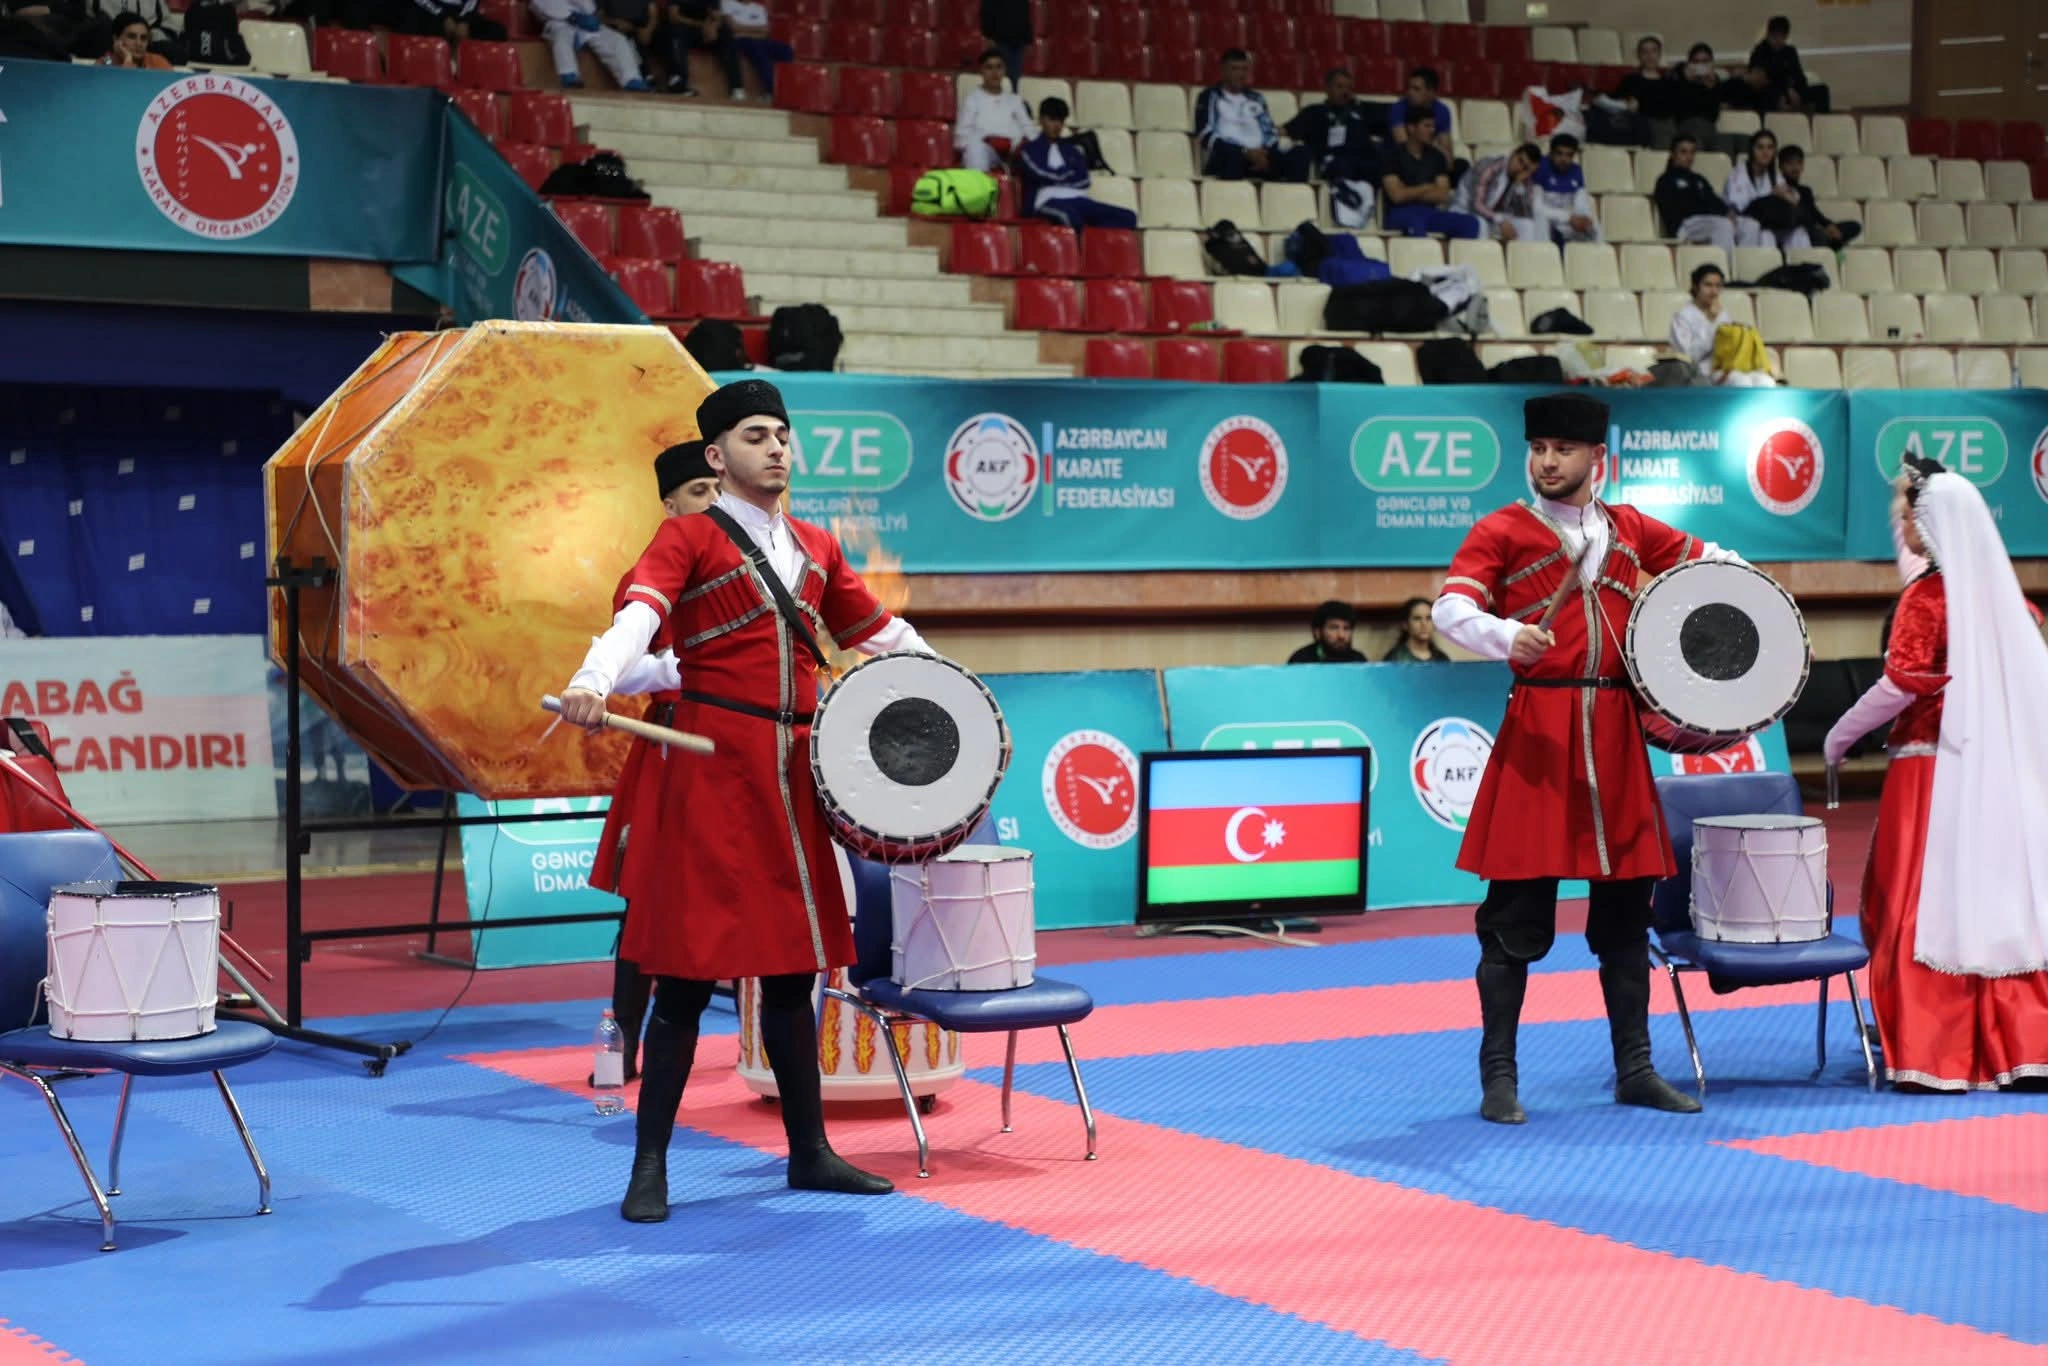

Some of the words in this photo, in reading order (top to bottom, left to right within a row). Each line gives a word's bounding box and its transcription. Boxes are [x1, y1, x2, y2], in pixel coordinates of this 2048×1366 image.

[148, 77, 286, 131] AZERBAIJAN
[143, 166, 188, 223] KARATE
[195, 174, 294, 236] ORGANIZATION
[457, 183, 500, 259] AZE
[1056, 428, 1168, 449] AZƏRBAYCAN
[1622, 430, 1720, 450] AZƏRBAYCAN
[1378, 431, 1473, 477] AZE
[975, 459, 1012, 474] AKF
[1056, 458, 1122, 479] KARATE
[1622, 458, 1680, 478] KARATE
[1056, 483, 1174, 508] FEDERASİYASI
[1622, 482, 1724, 505] FERASİYASI
[1444, 766, 1478, 782] AKF
[531, 849, 598, 870] GƏNC
[534, 871, 592, 893] İDMA
